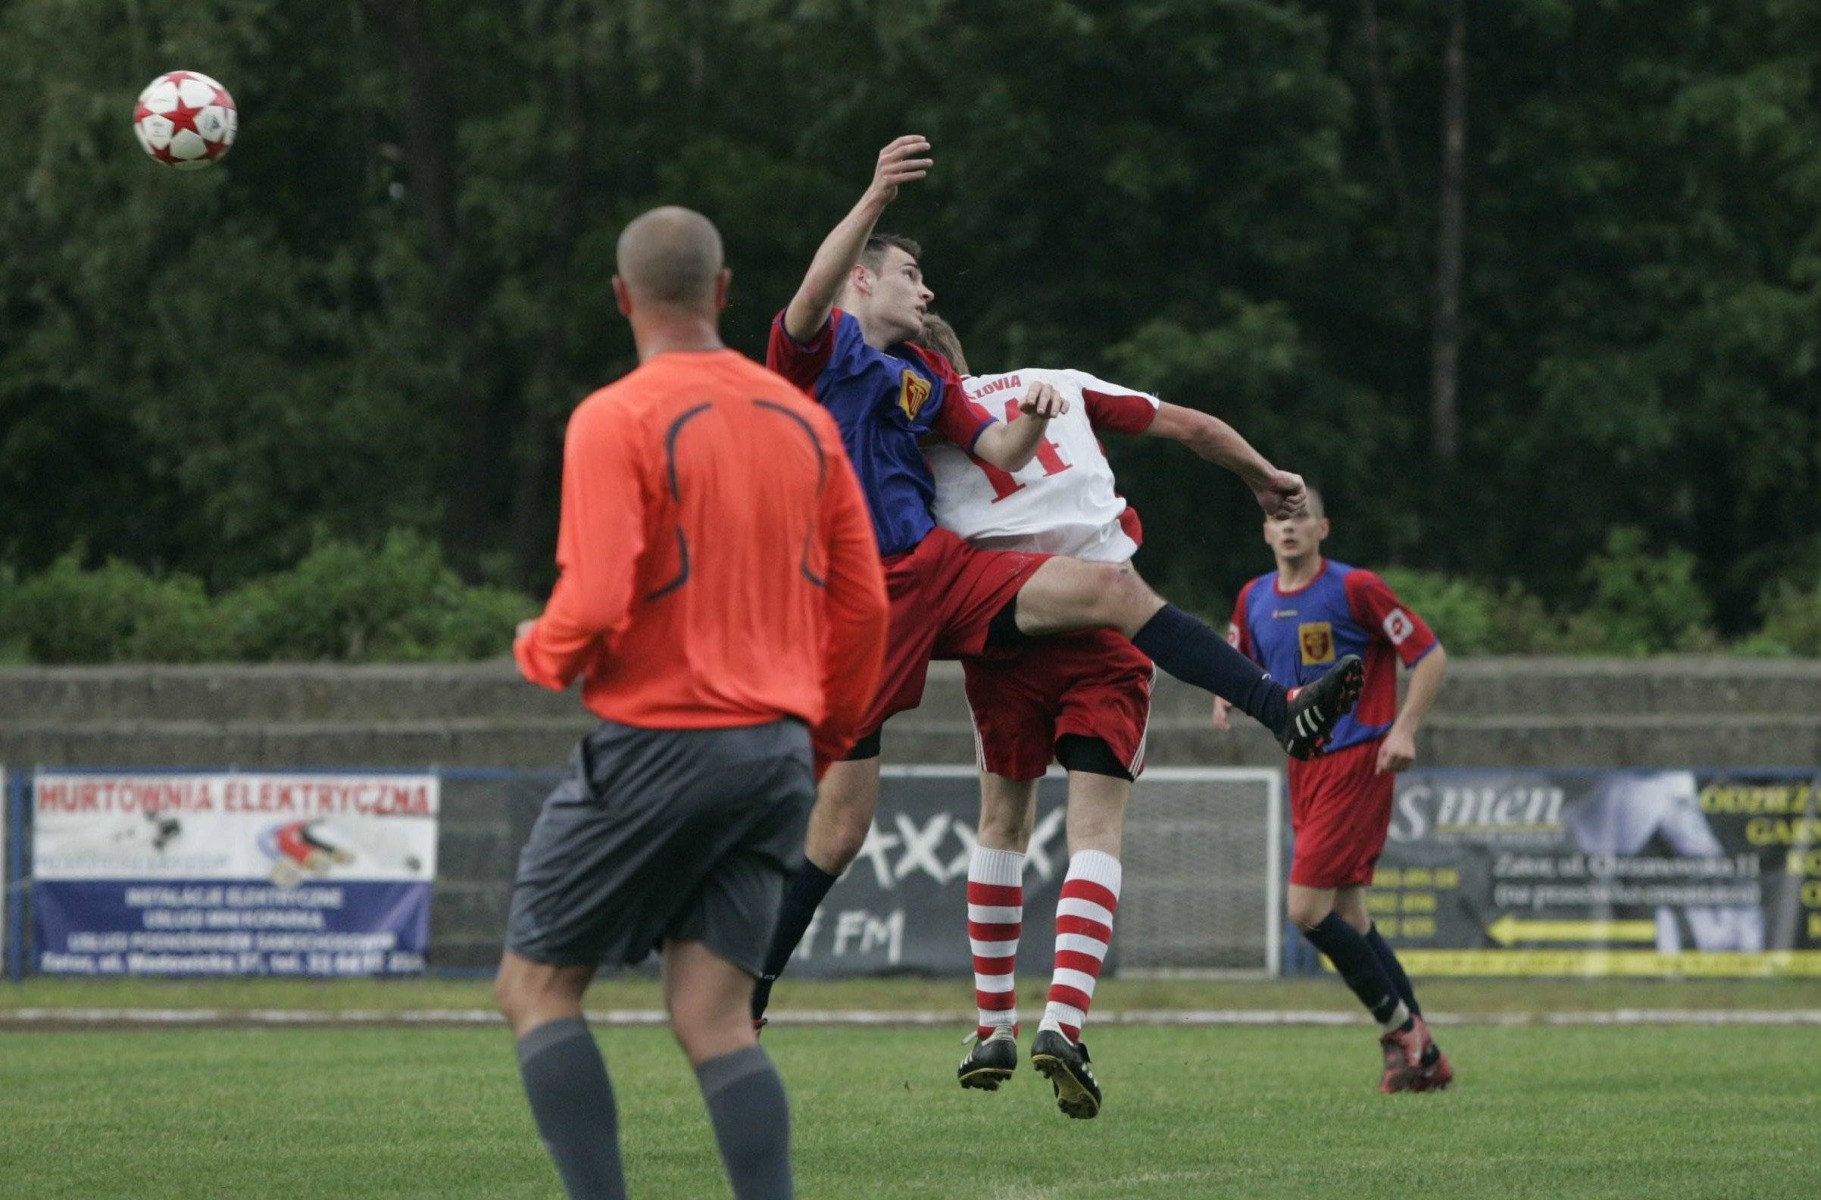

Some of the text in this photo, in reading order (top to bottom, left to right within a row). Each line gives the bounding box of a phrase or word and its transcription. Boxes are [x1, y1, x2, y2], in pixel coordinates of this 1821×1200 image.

[967, 374, 1022, 400] ZOVIA
[38, 780, 431, 816] HURTOWNIA ELEKTRYCZNA
[833, 907, 906, 964] FM
